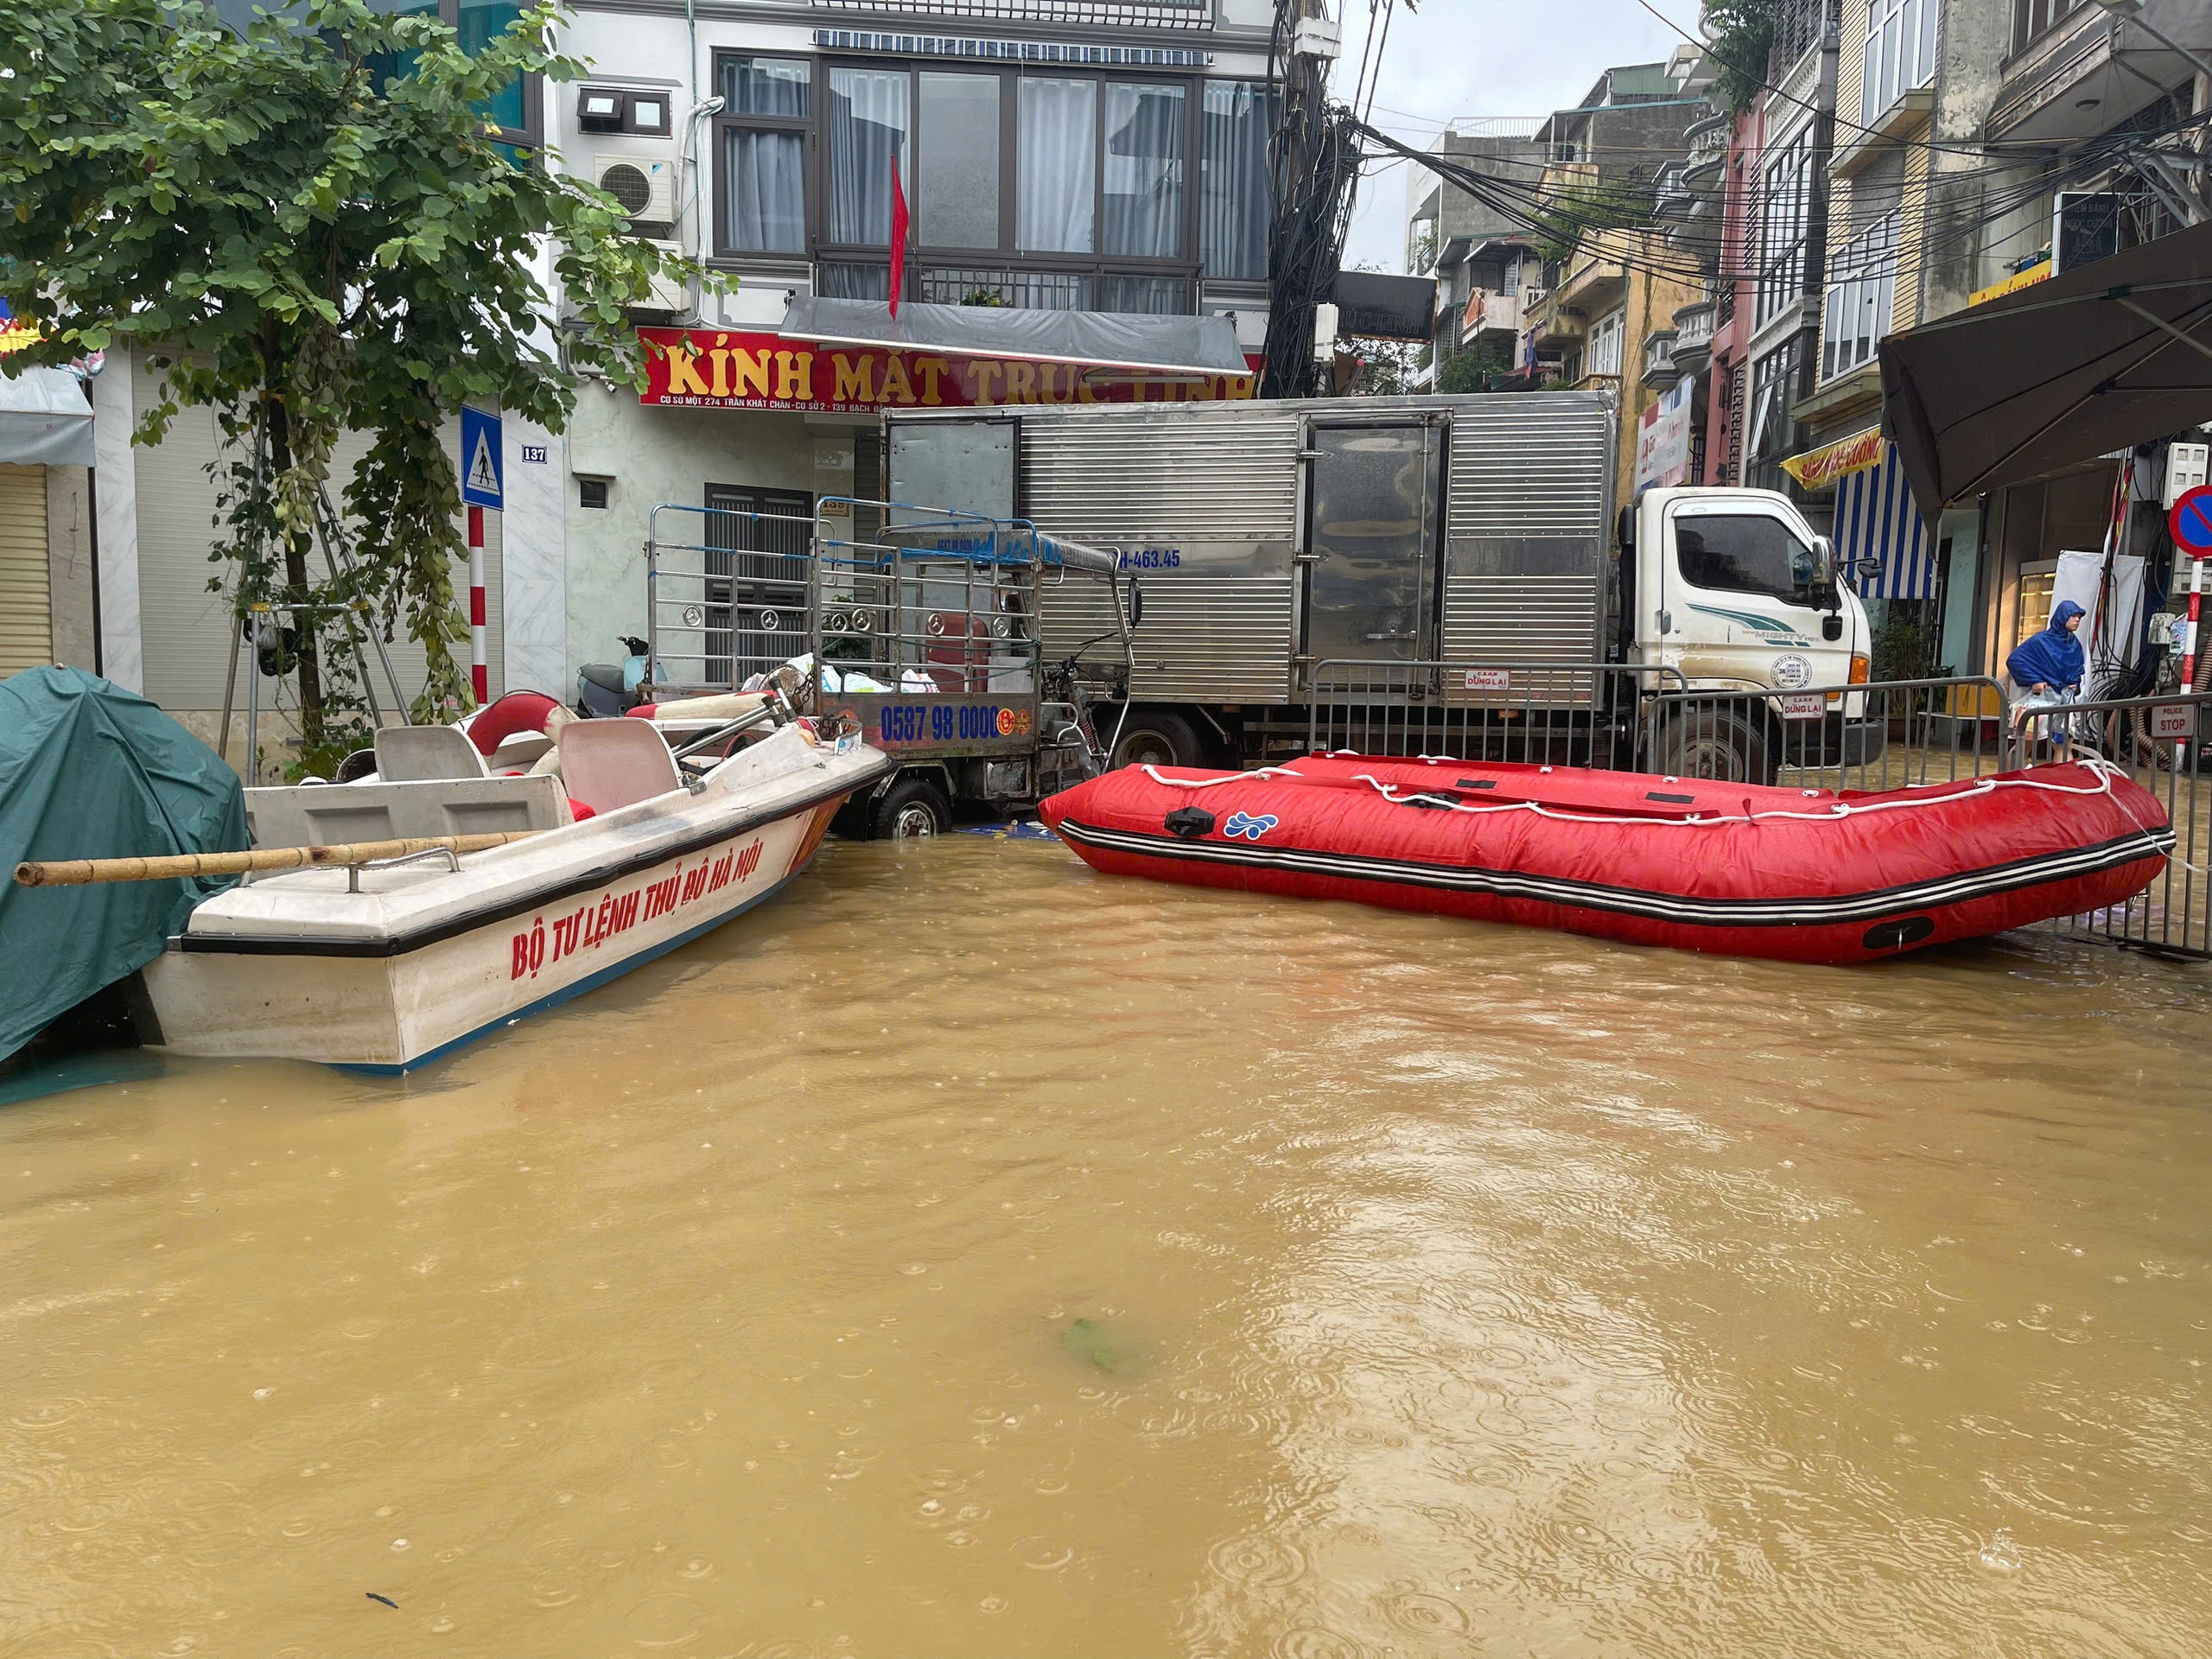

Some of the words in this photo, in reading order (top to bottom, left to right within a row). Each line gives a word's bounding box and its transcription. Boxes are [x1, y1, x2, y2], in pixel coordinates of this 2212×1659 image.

[665, 333, 814, 400] KÍNH
[820, 402, 825, 410] 2
[832, 403, 846, 411] 139
[524, 448, 544, 461] 137
[1113, 550, 1180, 569] H-463.45
[1755, 631, 1806, 641] MIGHTY
[881, 705, 926, 741] 0587
[931, 705, 954, 741] 98
[959, 705, 999, 740] 0000
[2160, 719, 2185, 731] STOP
[511, 916, 544, 981] BỘ
[552, 906, 585, 963] TƯ
[583, 893, 641, 949] LỆNH
[643, 861, 683, 922] THỦ
[680, 856, 709, 906] ĐÔ
[708, 848, 734, 893] HÀ
[732, 836, 764, 883] NỘI
